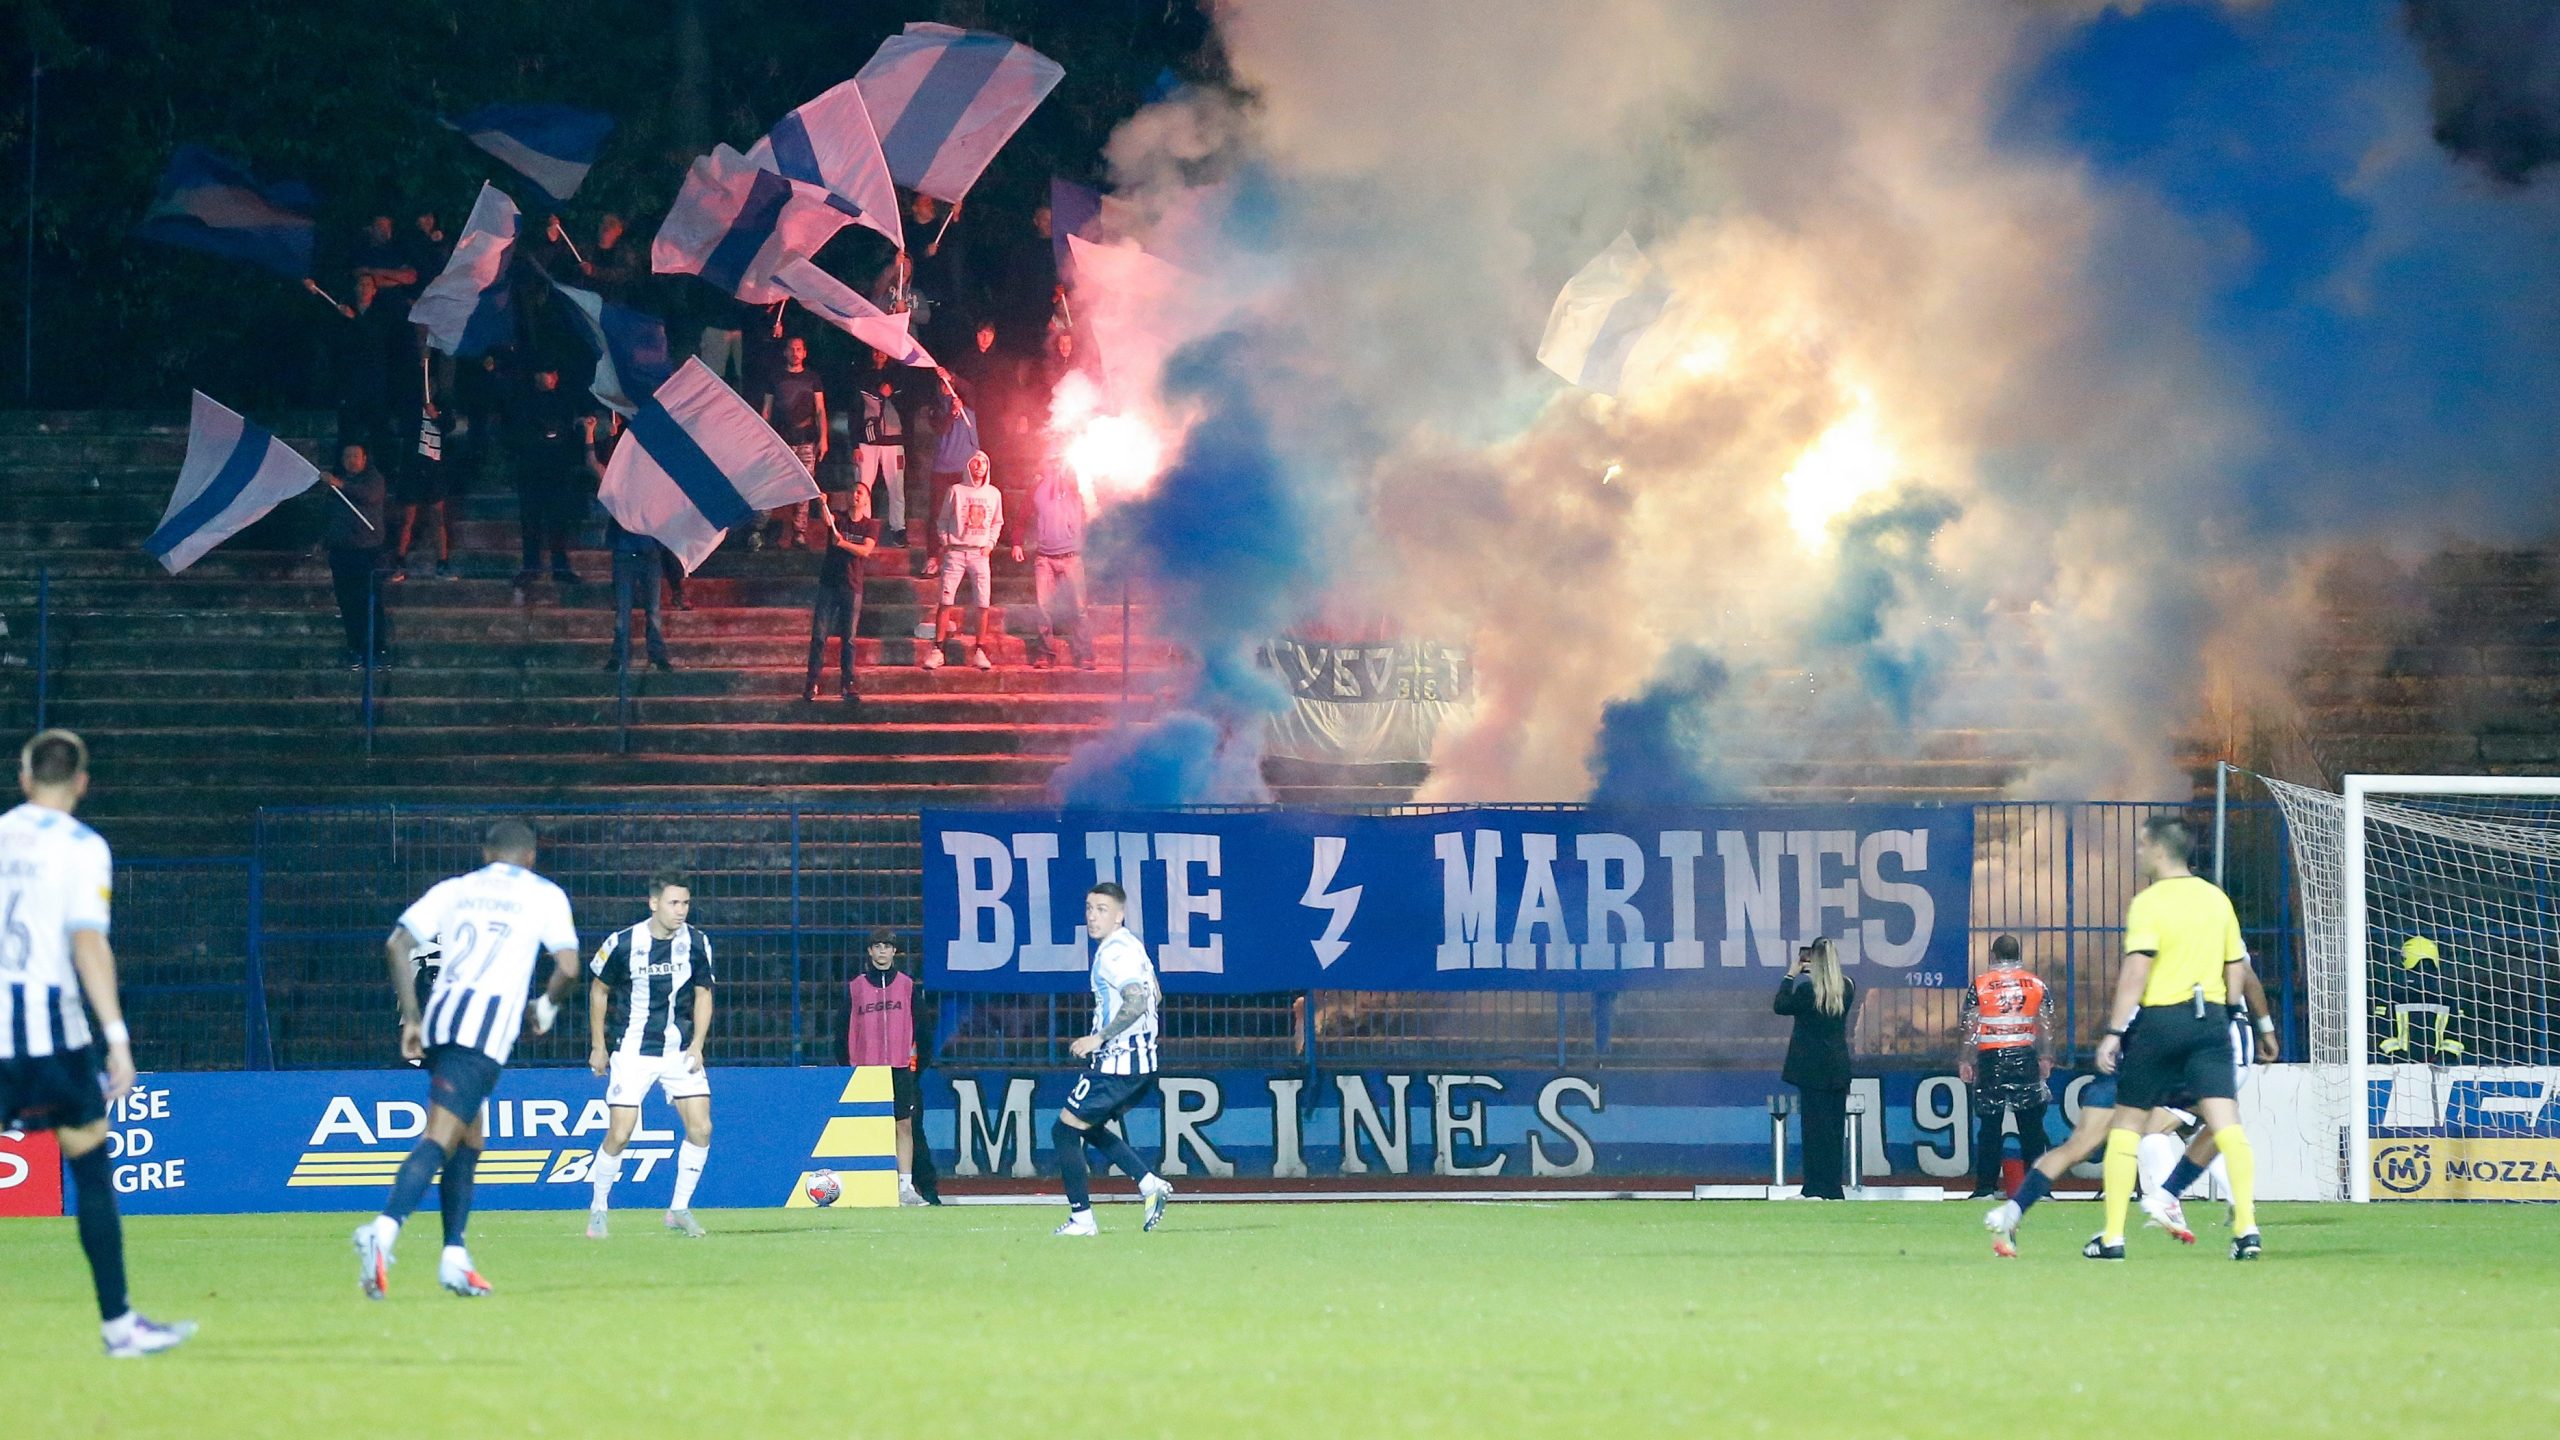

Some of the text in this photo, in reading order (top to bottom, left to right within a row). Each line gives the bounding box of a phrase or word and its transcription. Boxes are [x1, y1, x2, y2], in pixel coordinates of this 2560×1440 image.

[941, 829, 1935, 973] BLUE MARINES
[444, 920, 513, 984] 27
[638, 962, 684, 976] MAXBET
[1905, 971, 1944, 987] 1989
[858, 1000, 902, 1016] LEGEA
[309, 1096, 675, 1146] ADIRAL
[952, 1074, 1600, 1178] MRINES
